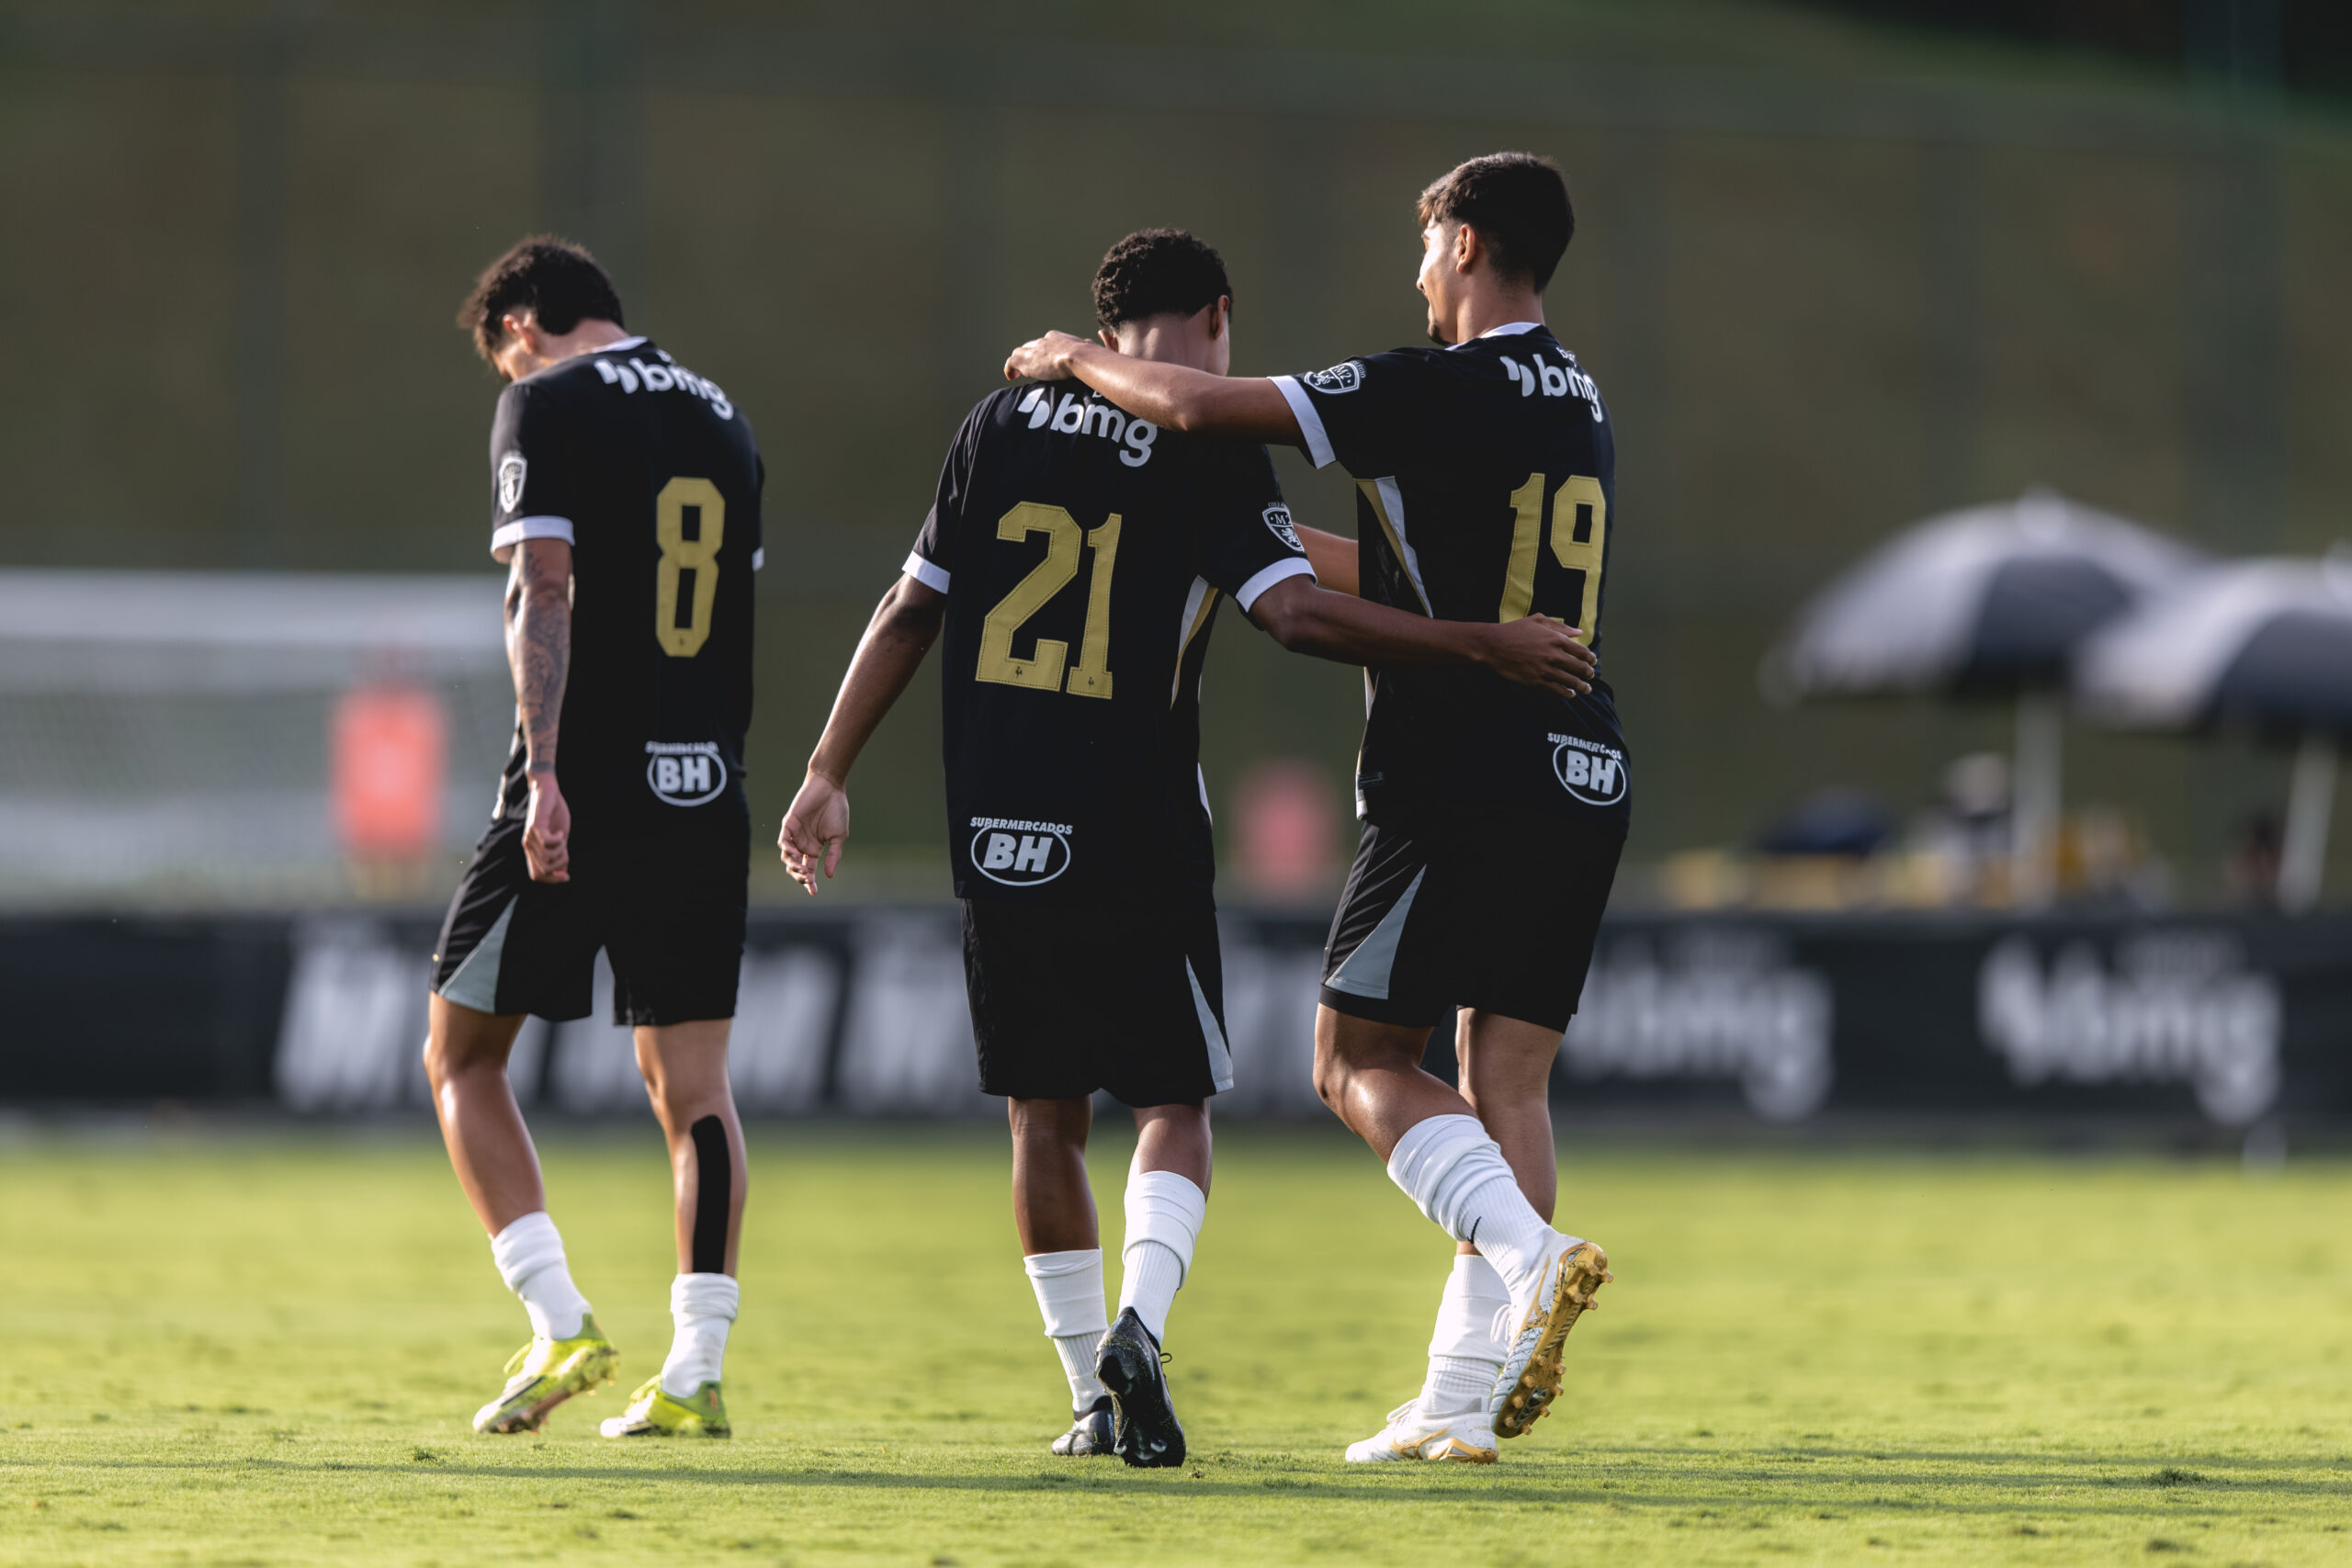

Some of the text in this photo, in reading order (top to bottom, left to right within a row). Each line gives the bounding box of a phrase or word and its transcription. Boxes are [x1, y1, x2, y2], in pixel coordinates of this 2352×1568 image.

[628, 357, 734, 421] bmg
[1532, 354, 1603, 423] bmg
[1050, 393, 1159, 468] bmg
[656, 476, 726, 659] 8
[1499, 472, 1607, 647] 19
[975, 501, 1123, 700] 21
[657, 756, 711, 794] BH
[1566, 750, 1617, 795] BH
[970, 817, 1073, 835] SUPERMERCADOS
[982, 832, 1054, 873] BH
